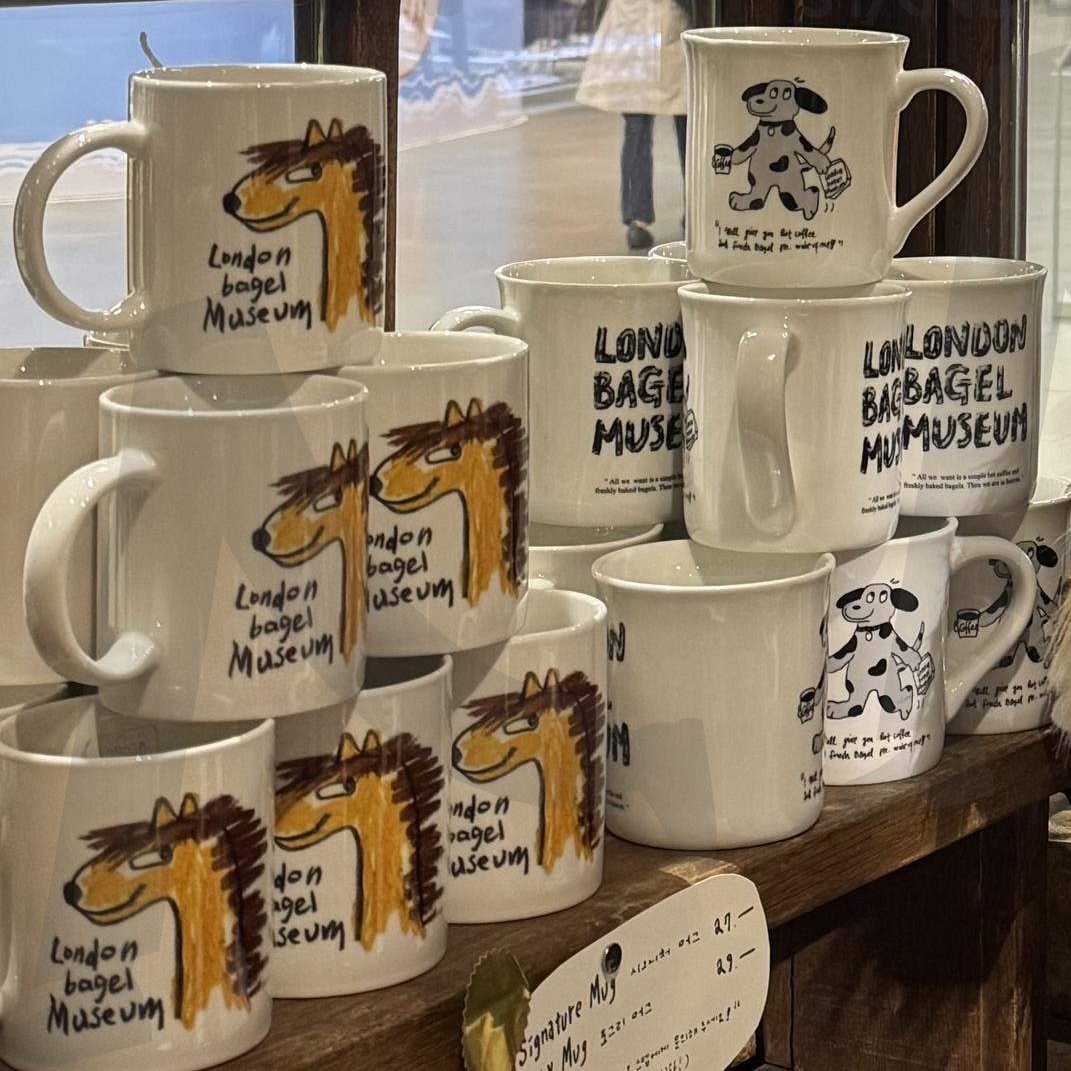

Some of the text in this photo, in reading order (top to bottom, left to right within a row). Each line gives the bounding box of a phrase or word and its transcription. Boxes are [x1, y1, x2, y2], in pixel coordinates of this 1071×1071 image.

[208, 243, 291, 274] London
[221, 271, 286, 304] bagel
[203, 296, 312, 333] Museum
[904, 314, 1028, 361] LONDON
[903, 363, 1013, 406] BAGEL
[903, 402, 1028, 452] MUSEUM
[925, 480, 943, 489] baked
[367, 551, 428, 584] bagel
[235, 580, 317, 612] London
[367, 578, 454, 613] useum
[249, 606, 313, 643] bagel
[228, 633, 333, 678] Museum
[50, 936, 138, 971] London
[274, 920, 345, 951] seum
[64, 967, 134, 1004] bagel
[47, 993, 164, 1036] Museum
[519, 974, 616, 1067] Signature Mug
[562, 1036, 587, 1071] Mug
